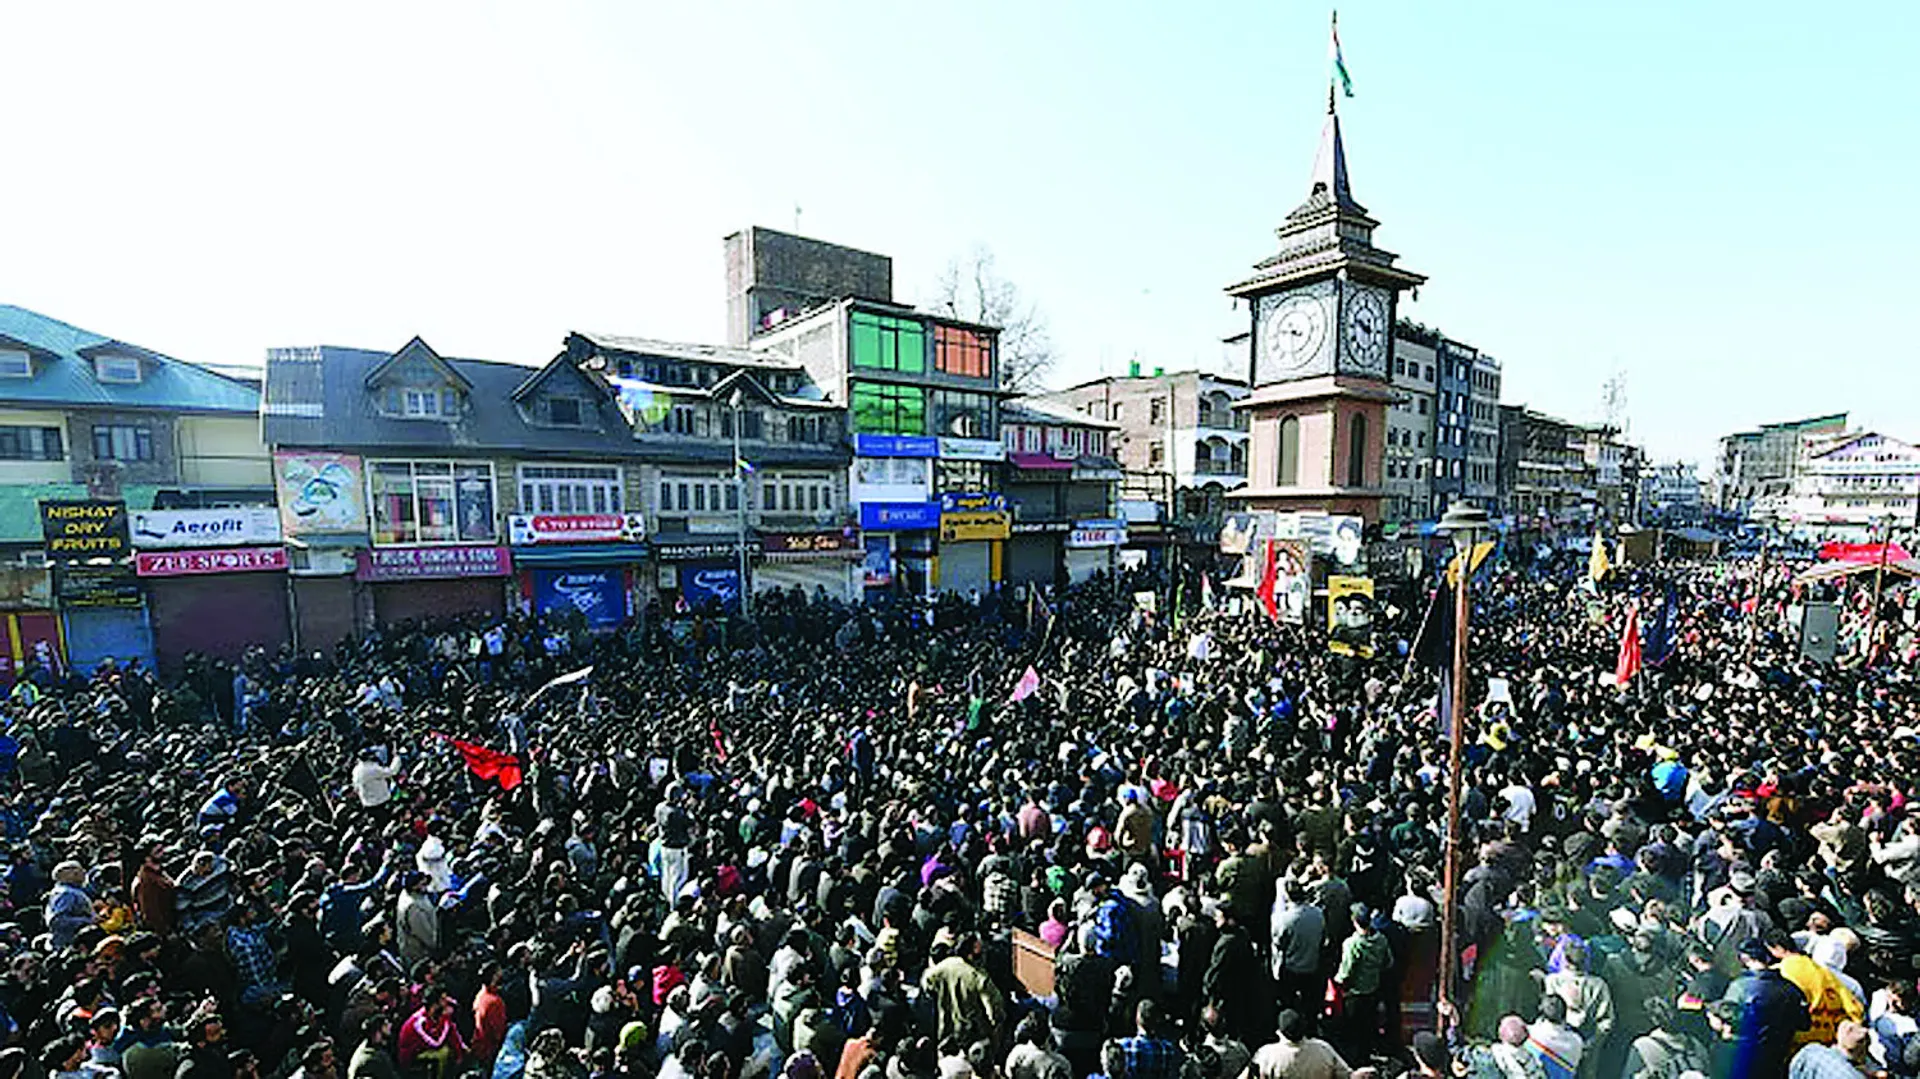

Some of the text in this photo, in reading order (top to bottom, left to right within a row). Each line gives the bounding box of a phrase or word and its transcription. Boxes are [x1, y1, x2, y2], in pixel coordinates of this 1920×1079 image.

[48, 506, 116, 518] NISHAT
[65, 523, 104, 534] DRY
[172, 519, 243, 533] Aerofit
[52, 538, 121, 550] FRUITS
[199, 553, 275, 568] SPORTS
